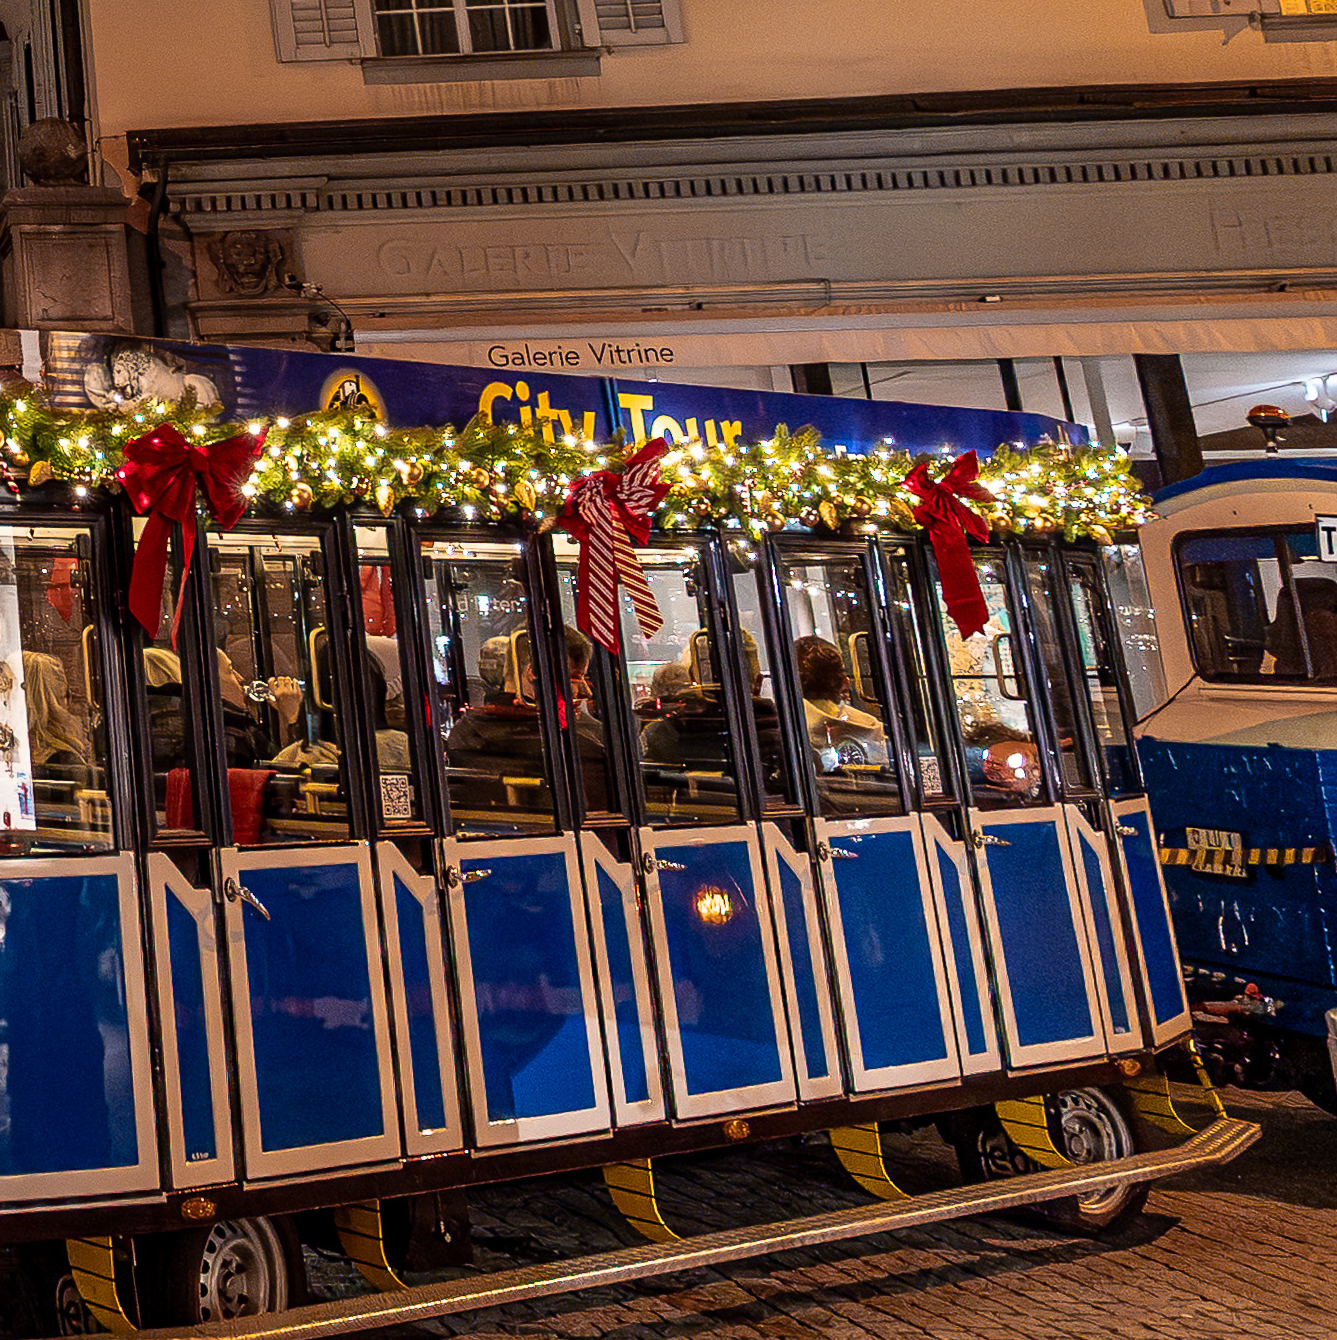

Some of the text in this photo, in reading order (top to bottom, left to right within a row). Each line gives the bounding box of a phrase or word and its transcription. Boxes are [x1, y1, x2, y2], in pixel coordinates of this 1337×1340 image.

[487, 342, 675, 367] Galerie Vitrine
[617, 392, 743, 450] Tour
